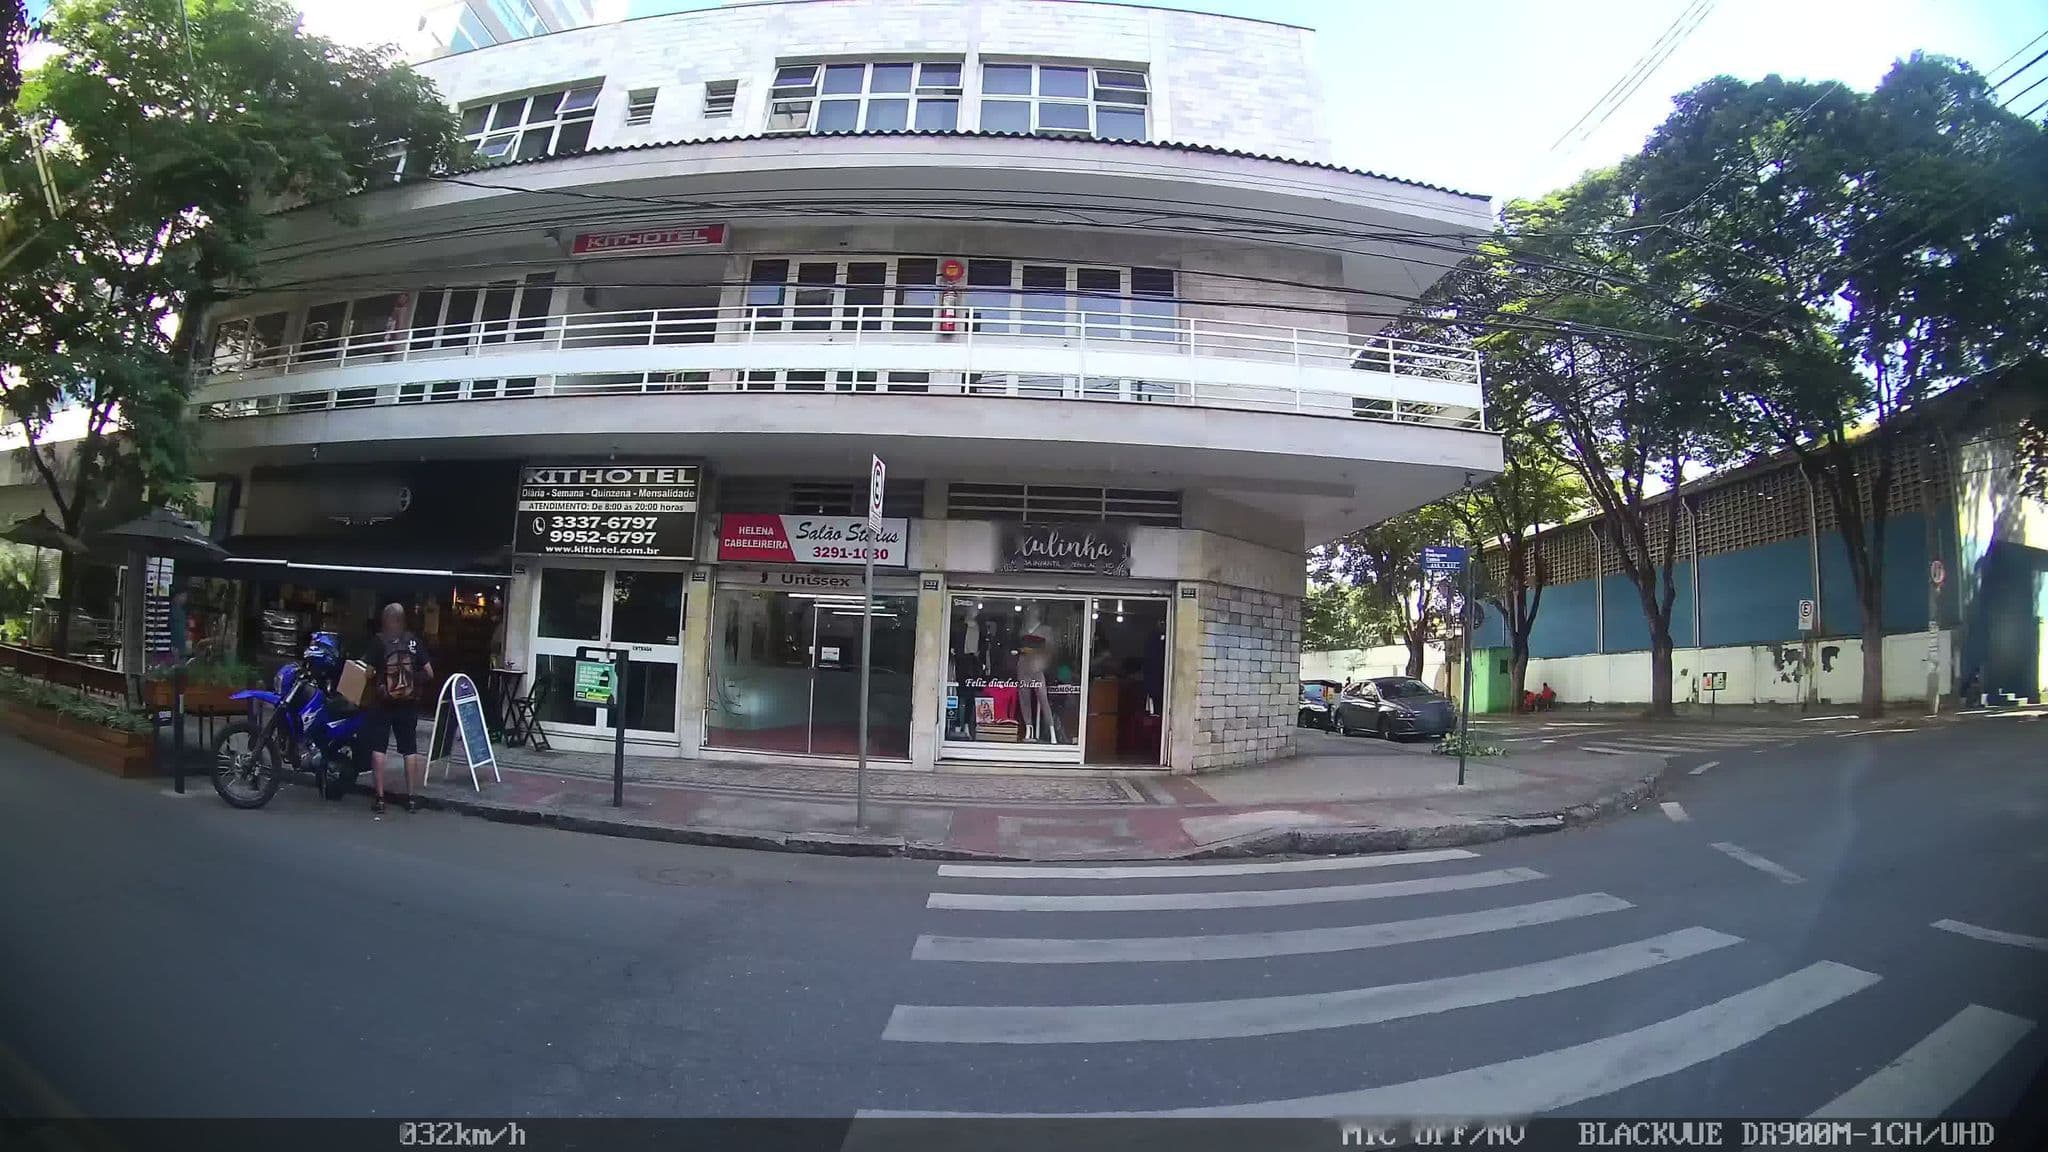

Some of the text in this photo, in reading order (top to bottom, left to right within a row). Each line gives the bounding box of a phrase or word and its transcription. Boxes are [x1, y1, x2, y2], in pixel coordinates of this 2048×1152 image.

[587, 230, 708, 247] KITHOTEL
[526, 470, 694, 483] KITHOTEL
[551, 489, 584, 497] Semana
[591, 488, 631, 498] Quinzena
[638, 488, 694, 498] Mensalidade
[528, 503, 590, 511] ATENDIMENTO:
[635, 503, 658, 511] 20:00
[551, 516, 658, 529] 3337-6797
[739, 526, 775, 536] HELENA
[796, 522, 843, 541] Salão
[550, 531, 657, 544] 9952-6797
[724, 539, 788, 549] CABELEIREIRA
[545, 545, 660, 555] www.kithotel.com.br
[781, 573, 850, 587] Unissex
[965, 678, 987, 688] Feliz
[1003, 678, 1019, 688] das
